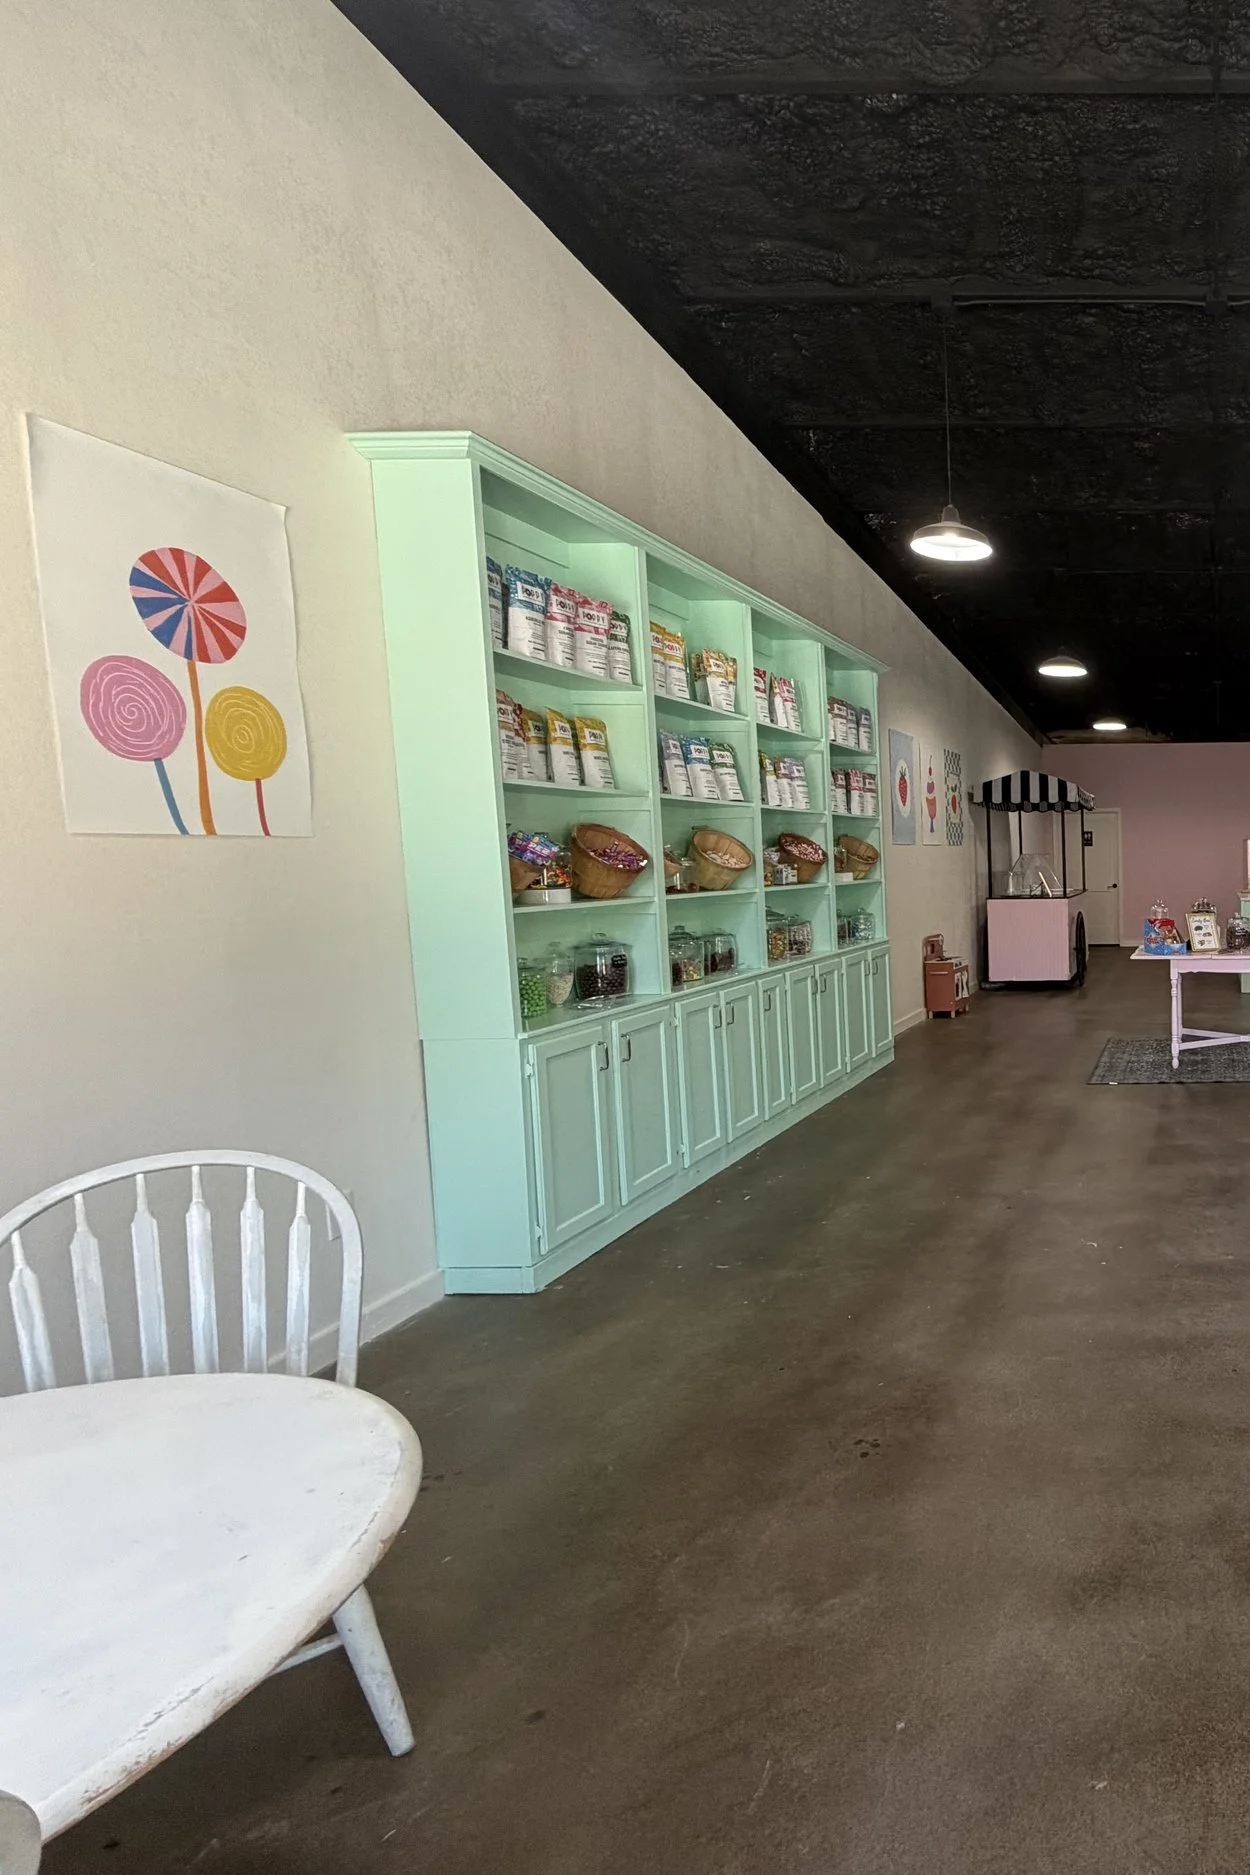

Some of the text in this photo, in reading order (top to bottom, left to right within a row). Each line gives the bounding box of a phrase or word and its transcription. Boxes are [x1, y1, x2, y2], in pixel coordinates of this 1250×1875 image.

[521, 584, 545, 601] POPPY
[582, 610, 606, 623] POPPY
[527, 841, 551, 855] PEZ
